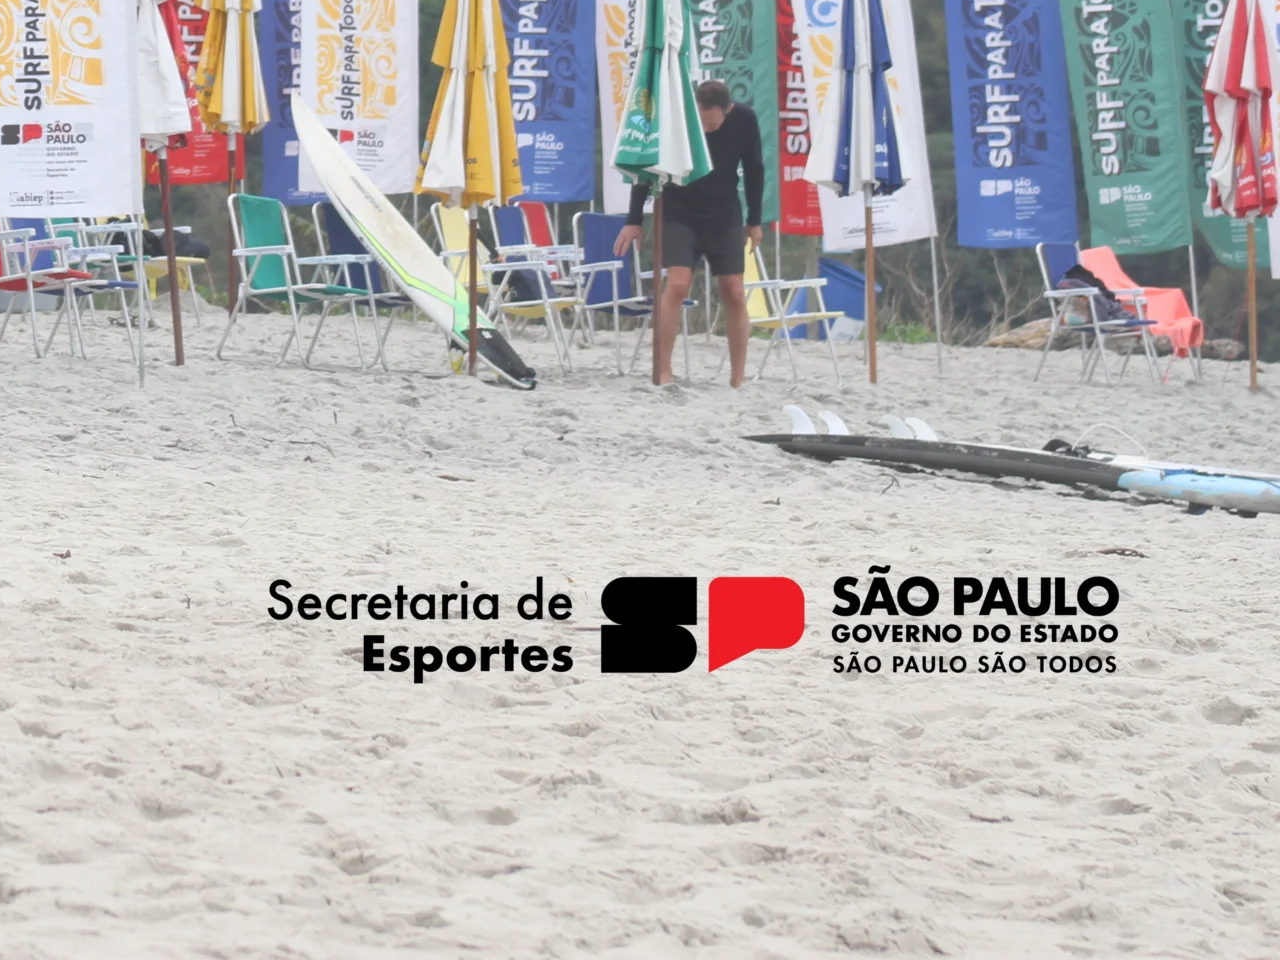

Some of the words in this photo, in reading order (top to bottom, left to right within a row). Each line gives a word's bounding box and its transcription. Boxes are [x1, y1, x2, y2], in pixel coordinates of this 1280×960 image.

[984, 11, 1015, 79] PARA
[343, 33, 360, 72] PARA
[1090, 17, 1120, 87] PARA
[16, 42, 51, 111] SURF
[509, 37, 549, 122] SURF
[335, 74, 361, 121] SURF
[46, 120, 72, 133] SÃO
[976, 84, 1021, 169] SURF
[46, 134, 87, 144] PAULO
[357, 129, 376, 140] SÃO
[535, 131, 555, 141] SÃO
[1092, 91, 1126, 175] SURF
[357, 140, 385, 148] PAULO
[535, 141, 564, 150] PAULO
[1015, 177, 1031, 187] SÃO
[1015, 187, 1041, 195] PAULO
[1122, 184, 1142, 194] SÃO
[1123, 193, 1153, 203] PAULO
